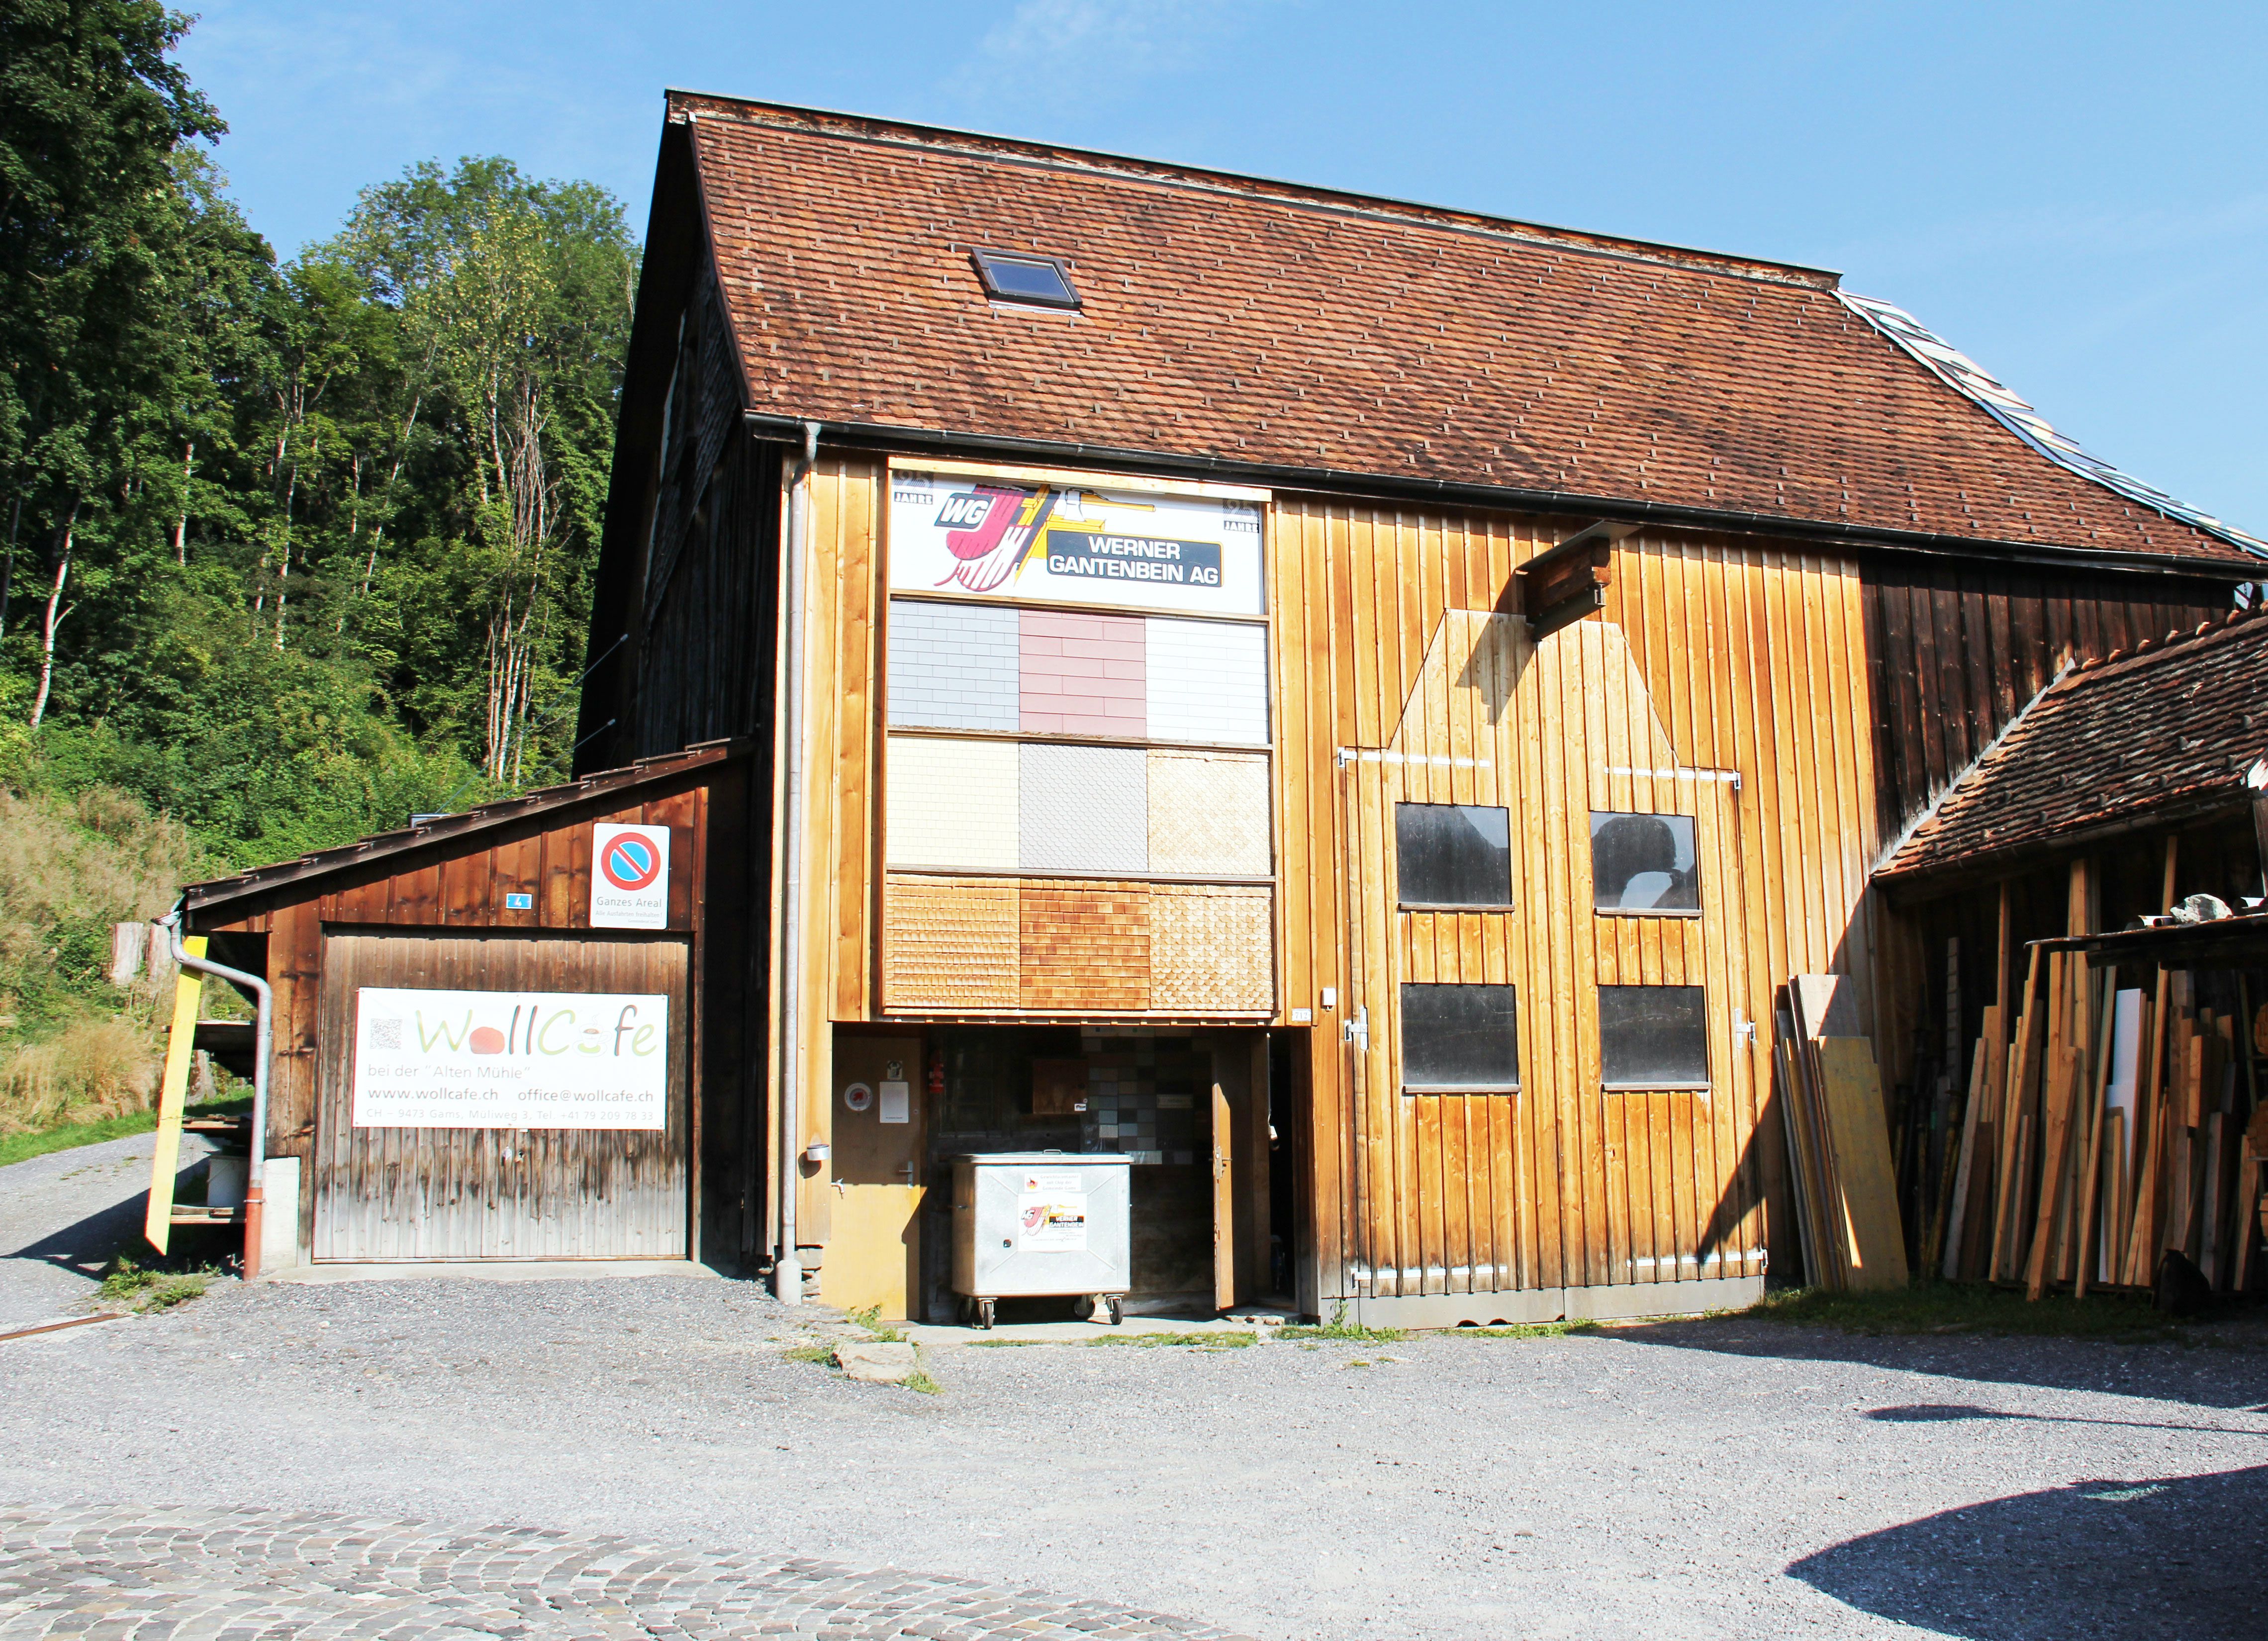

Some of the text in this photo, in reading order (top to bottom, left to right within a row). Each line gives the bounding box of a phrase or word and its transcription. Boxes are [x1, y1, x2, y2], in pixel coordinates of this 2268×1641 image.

[895, 492, 932, 504] JAHRE
[940, 497, 989, 525] WG
[1225, 521, 1258, 533] JAHRE
[1088, 536, 1181, 560] WERNER
[1049, 554, 1219, 585] GANTENBEIN AG
[596, 897, 662, 908] Ganzes Areal
[368, 1064, 389, 1076] bei
[394, 1064, 419, 1077] der
[368, 1087, 654, 1102] www.wollcafe.ch office@wollcafe.ch
[367, 1108, 382, 1117] CH
[398, 1108, 425, 1118] 9473
[430, 1109, 464, 1119] Gams,
[469, 1109, 518, 1121] Müliweg
[537, 1110, 556, 1119] Tel.
[561, 1111, 579, 1119] +41
[584, 1111, 596, 1120] 79
[600, 1111, 620, 1120] 209
[625, 1111, 637, 1120] 78
[641, 1111, 654, 1120] 33
